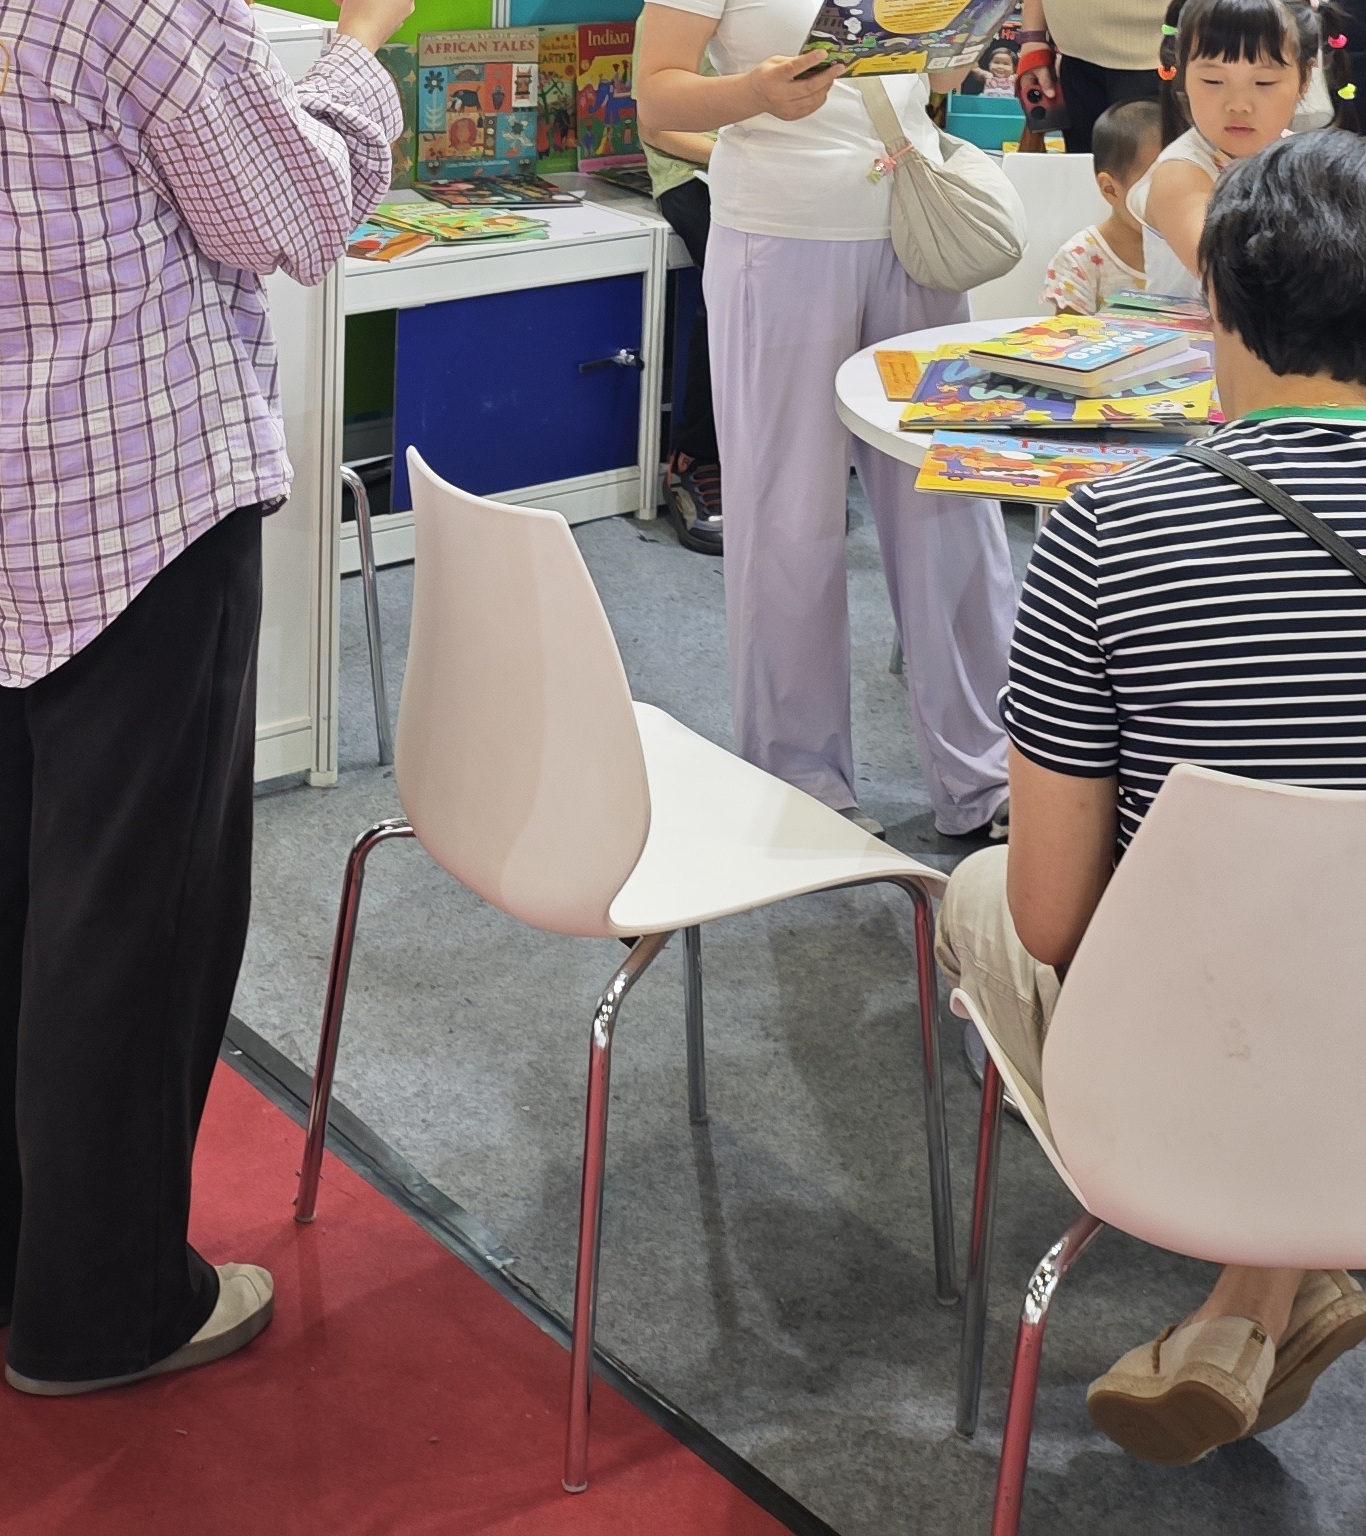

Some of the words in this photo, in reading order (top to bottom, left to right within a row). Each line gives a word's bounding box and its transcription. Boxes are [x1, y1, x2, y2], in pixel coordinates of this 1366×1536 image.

[424, 41, 488, 54] AFRICAN
[492, 40, 535, 52] TALES
[588, 30, 630, 47] Indian
[1019, 438, 1149, 456] Tractor
